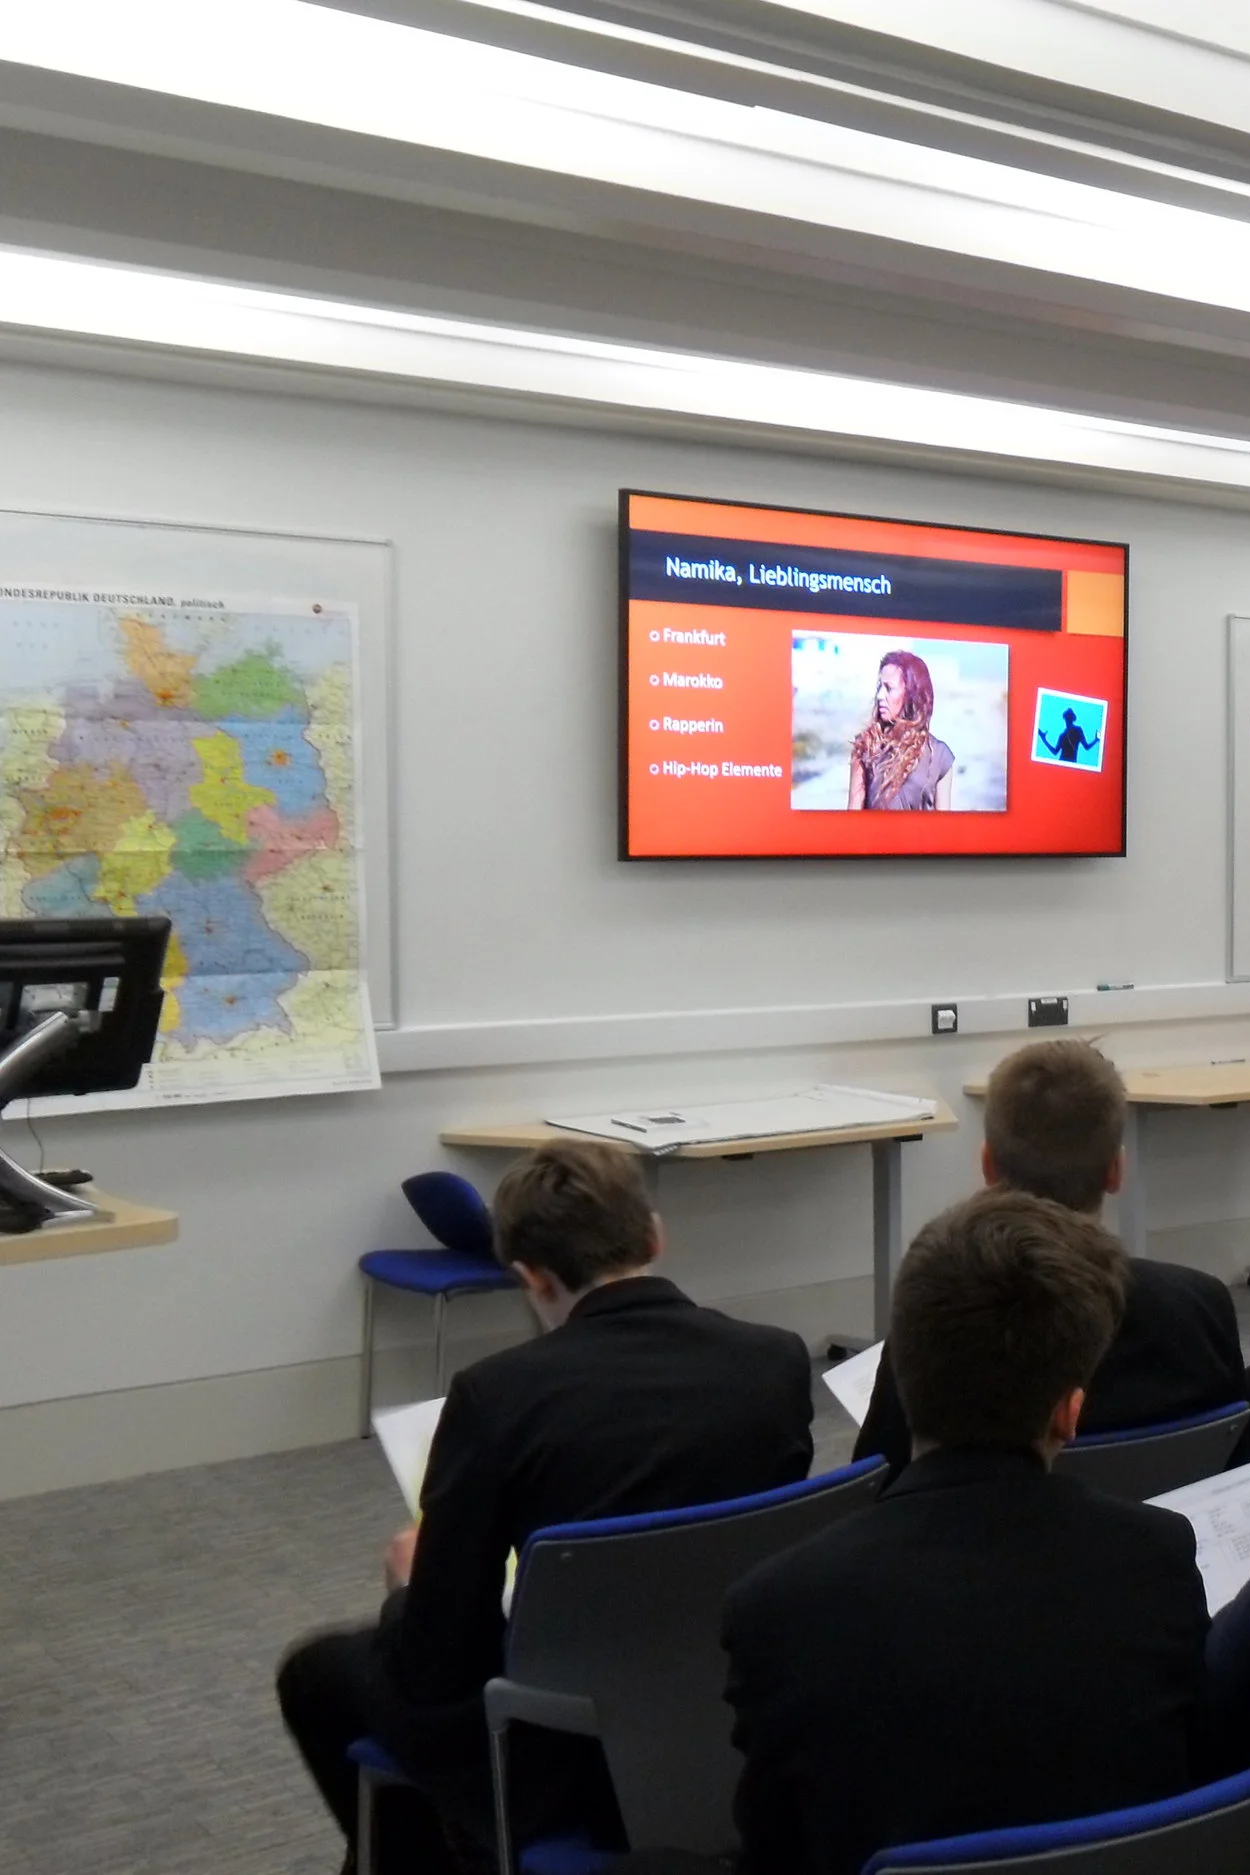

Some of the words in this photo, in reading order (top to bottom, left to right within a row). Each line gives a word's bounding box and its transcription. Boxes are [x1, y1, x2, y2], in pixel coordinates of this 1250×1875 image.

[665, 556, 743, 587] Namika,
[749, 564, 892, 595] Lieblingsmensch
[662, 627, 727, 647] Frankfurt
[662, 671, 724, 690] Marokko
[662, 716, 725, 735] Rapperin
[662, 760, 719, 779] Hip-Hop
[721, 761, 784, 778] Elemente
